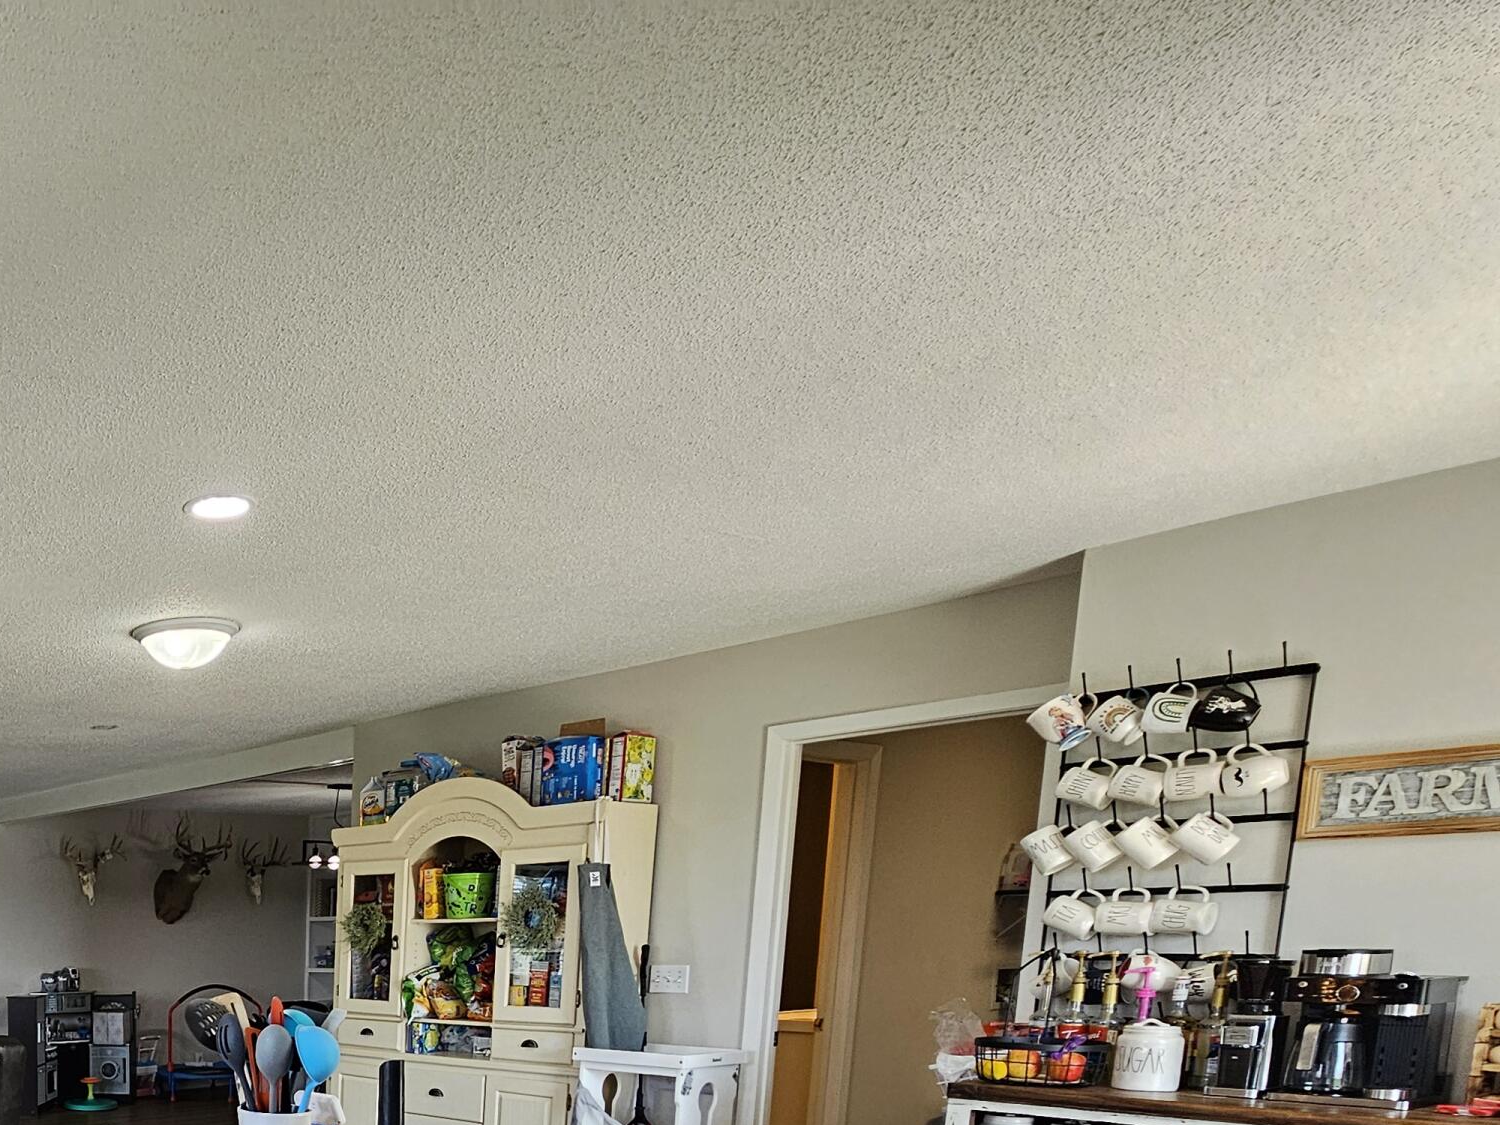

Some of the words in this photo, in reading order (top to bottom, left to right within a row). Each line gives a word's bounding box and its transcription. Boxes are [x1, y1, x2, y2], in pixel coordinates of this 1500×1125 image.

[1118, 773, 1146, 797] HAPPY
[1052, 904, 1080, 924] TEA
[1116, 1045, 1165, 1074] SUGAR
